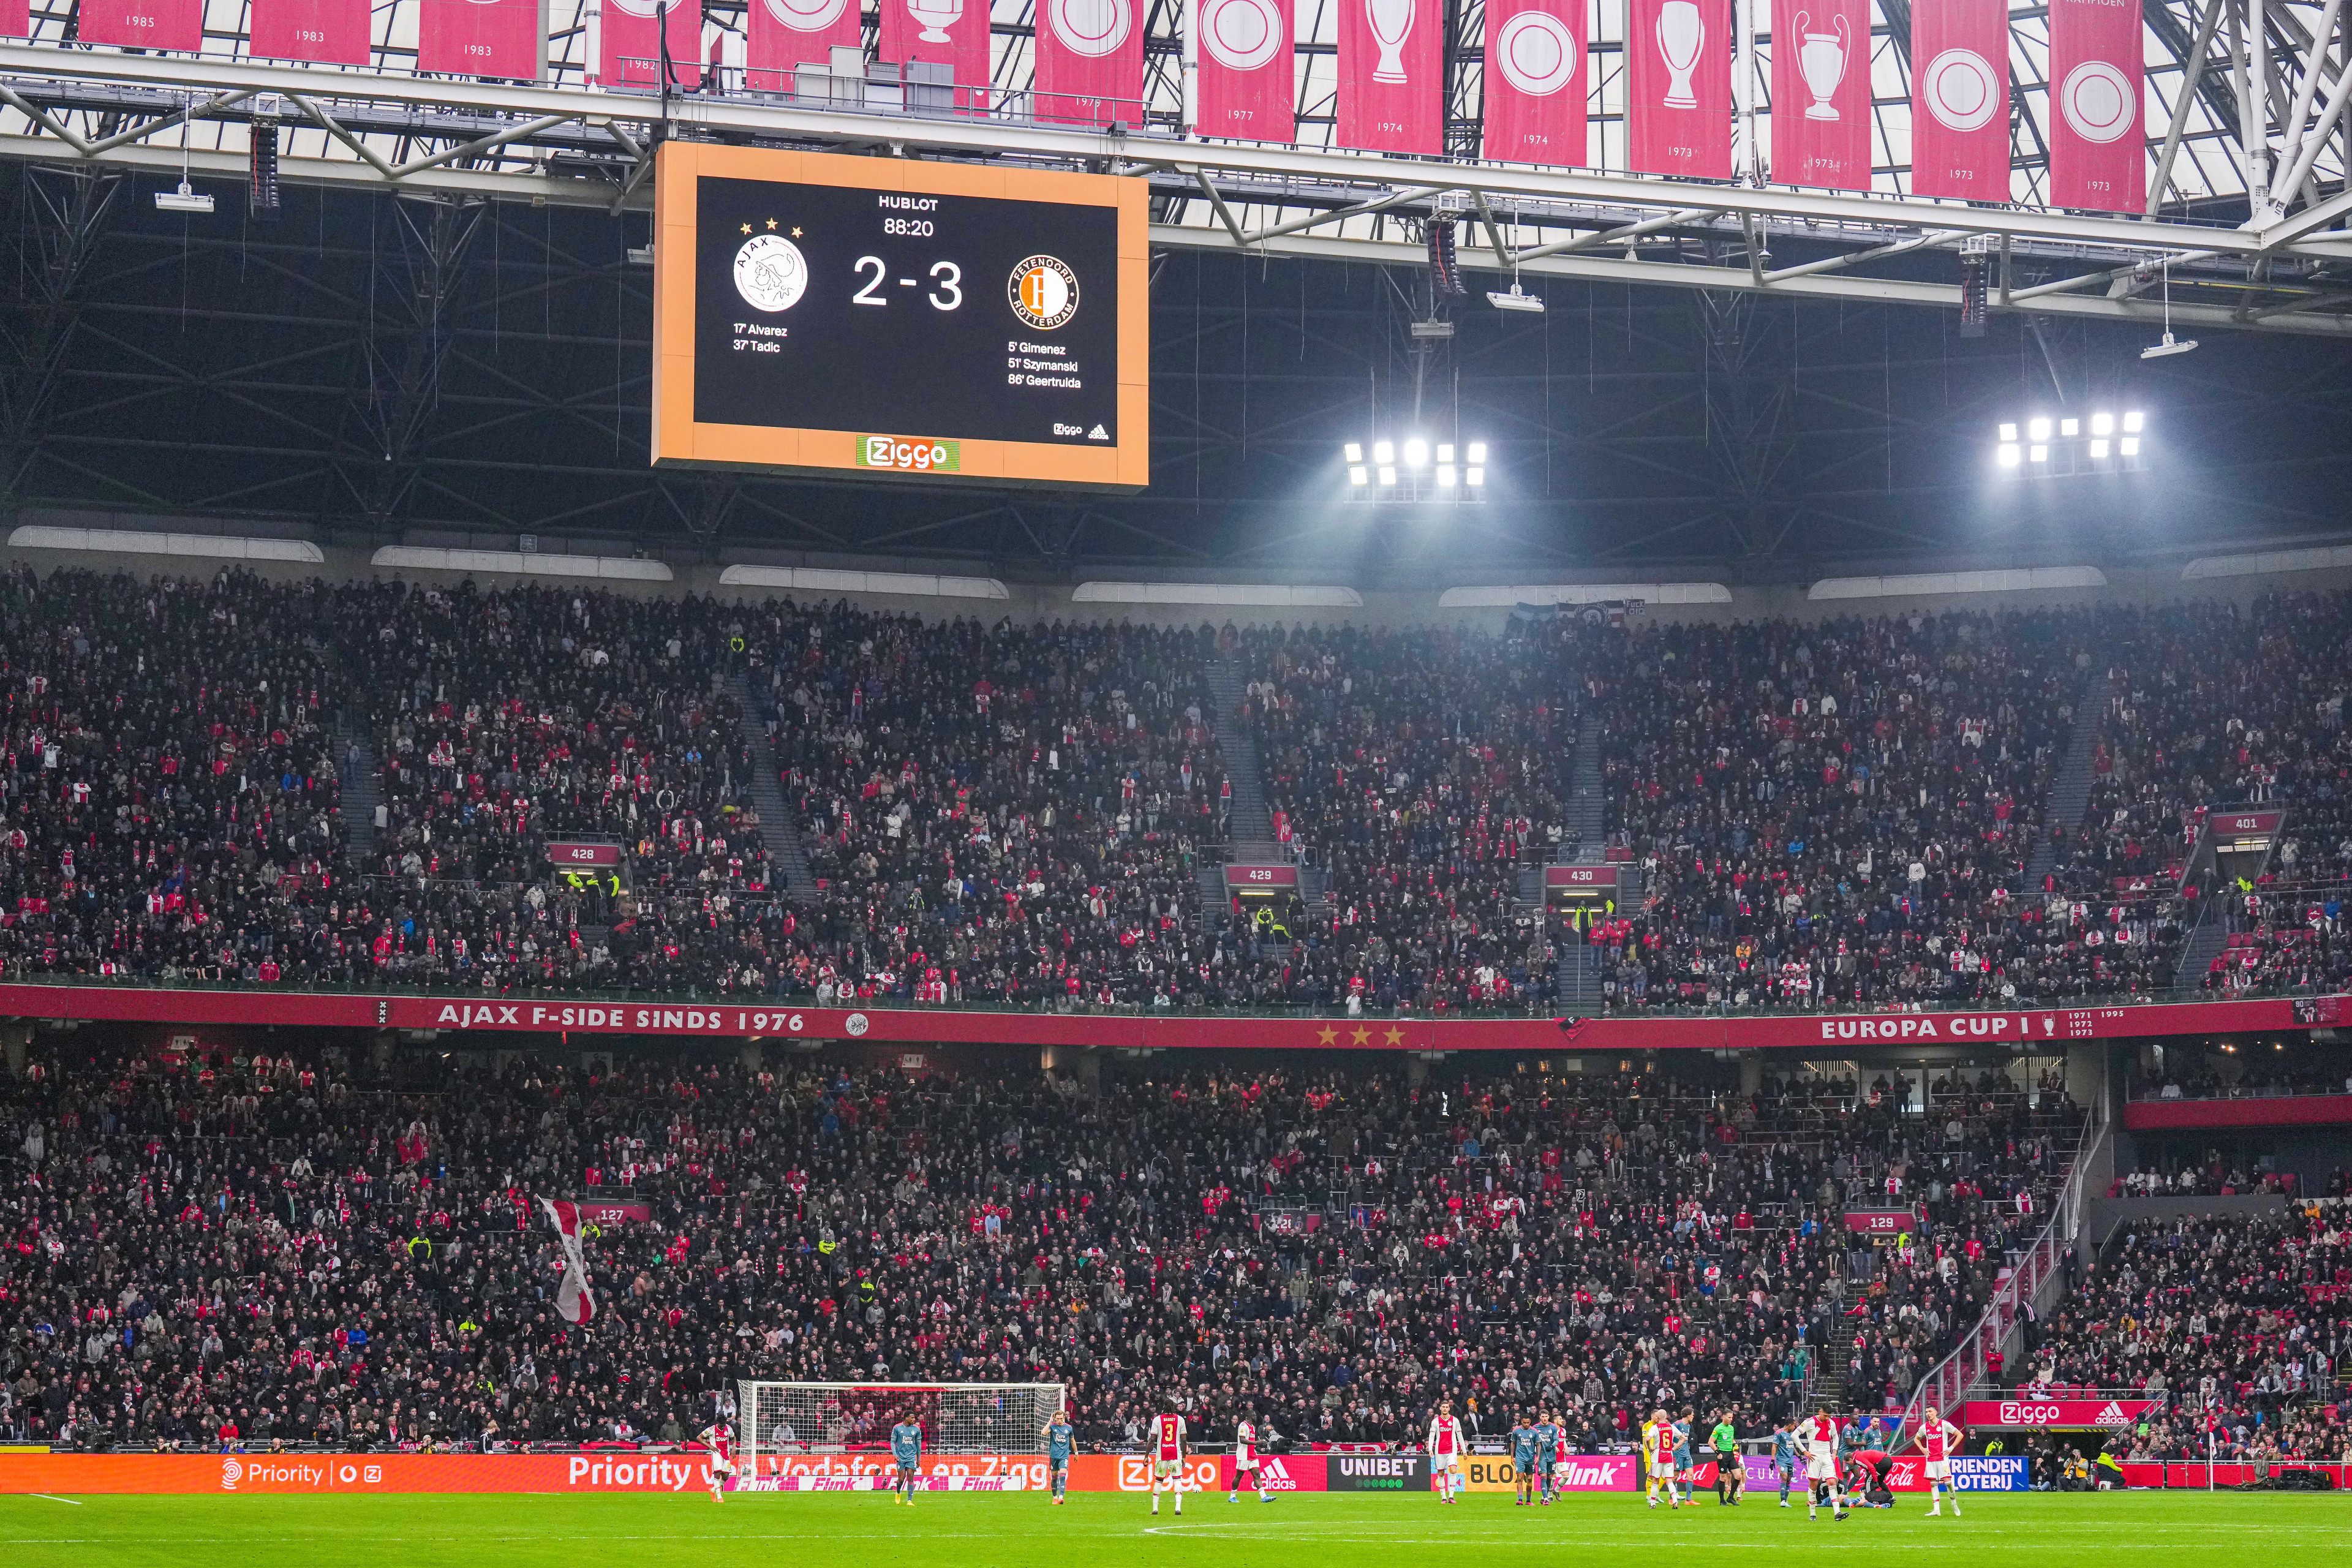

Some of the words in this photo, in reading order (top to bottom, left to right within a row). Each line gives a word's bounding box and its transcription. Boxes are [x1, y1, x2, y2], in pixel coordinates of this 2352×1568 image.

[126, 15, 155, 28] 1985
[296, 30, 325, 43] 1983
[464, 43, 492, 57] 1983
[1227, 109, 1253, 121] 1977
[1377, 121, 1403, 133] 1974
[1523, 134, 1548, 146] 1974
[1668, 146, 1694, 157] 1973
[1809, 157, 1834, 170] 1973
[1950, 169, 1973, 181] 1973
[2087, 180, 2111, 192] 1973
[878, 195, 938, 211] HUBLOT
[884, 218, 933, 237] 88:20
[737, 237, 768, 268] AJAX
[1014, 258, 1074, 285] FEYENOORD
[852, 255, 887, 306] 2
[929, 261, 963, 311] 3
[1013, 300, 1074, 328] ROTTERDAM
[748, 324, 788, 337] Alvarez
[750, 340, 780, 353] Tadic
[1008, 341, 1017, 352] 5'
[1019, 342, 1066, 355] Gimenez
[1008, 358, 1022, 369] 51'
[1023, 359, 1078, 372] Szymanski
[1008, 374, 1025, 385] 86'
[1027, 376, 1081, 388] Geertruida
[1054, 423, 1082, 435] Ziggo
[866, 437, 947, 469] Ziggo
[2236, 818, 2257, 829] 401
[571, 849, 594, 859] 428
[1250, 870, 1272, 880] 429
[1571, 871, 1593, 881] 430
[437, 1005, 519, 1028] AJAX
[532, 1006, 623, 1027] F-SIDE
[636, 1009, 722, 1029] SINDS
[737, 1012, 804, 1031] 1976
[2069, 1020, 2092, 1028] 1972
[1822, 1019, 1938, 1039] EUROPA
[1949, 1017, 2008, 1036] CUP
[601, 1210, 624, 1220] 127
[1871, 1218, 1893, 1227] 129
[2000, 1402, 2060, 1424] Ziggo
[2095, 1415, 2129, 1424] adidas
[1164, 1424, 1174, 1441] 3
[1662, 1432, 1670, 1449] 6
[1340, 1458, 1417, 1476] UNIBET
[1948, 1458, 2022, 1473] RIENDEN
[249, 1464, 323, 1487] Priority
[570, 1456, 691, 1491] Priority
[981, 1457, 1068, 1490] Zigg
[1470, 1464, 1528, 1483] BLO
[1556, 1462, 1627, 1485] link
